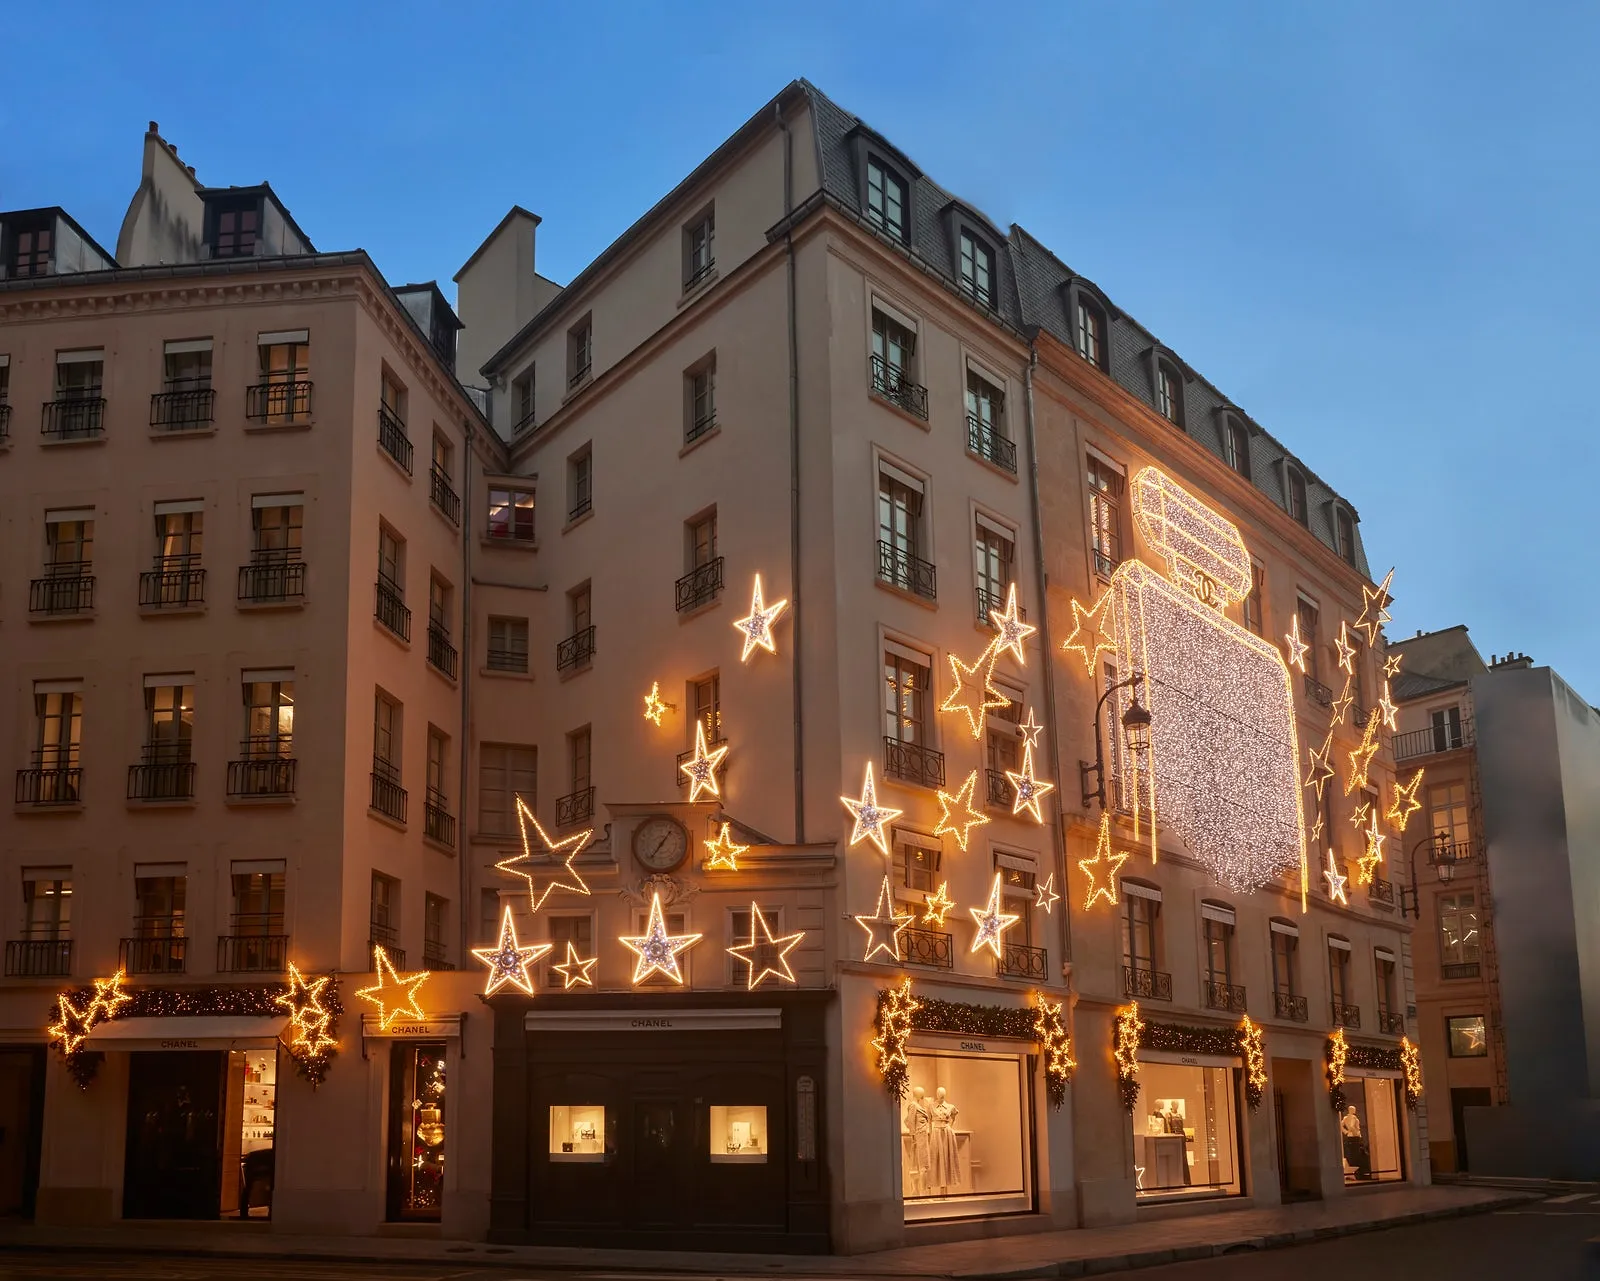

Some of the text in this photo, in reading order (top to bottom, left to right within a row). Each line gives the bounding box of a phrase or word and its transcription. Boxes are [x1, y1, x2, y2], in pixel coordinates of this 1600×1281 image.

[631, 1020, 673, 1028] CHANEL
[391, 1026, 430, 1034] CHANEL
[160, 1040, 199, 1048] CHANEL
[960, 1041, 986, 1051] CHANEL
